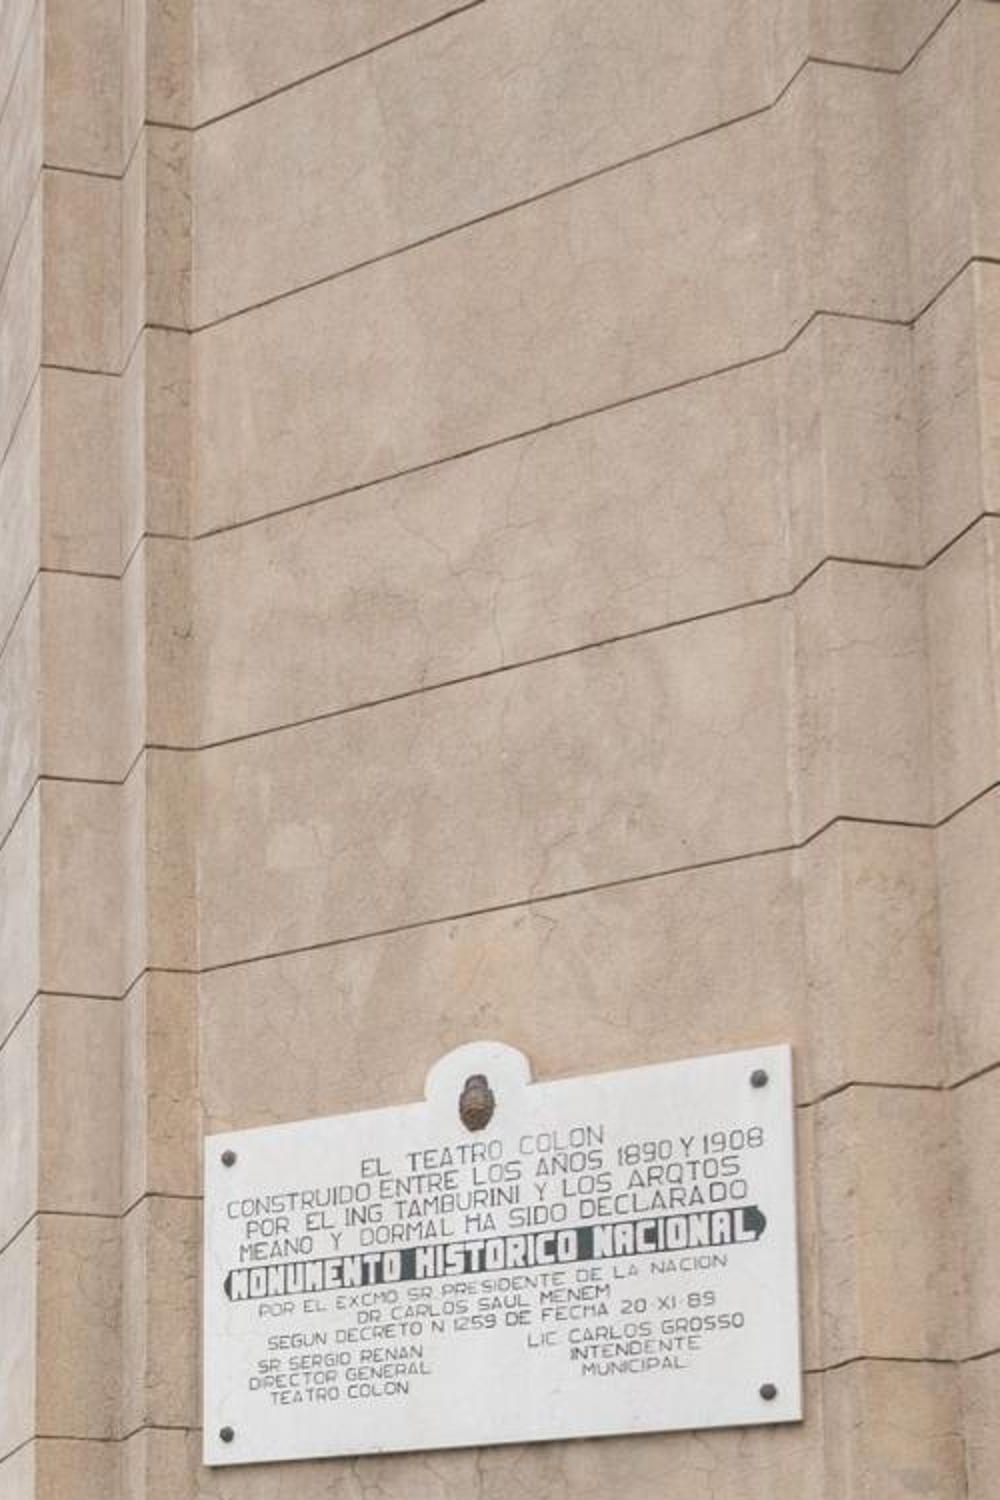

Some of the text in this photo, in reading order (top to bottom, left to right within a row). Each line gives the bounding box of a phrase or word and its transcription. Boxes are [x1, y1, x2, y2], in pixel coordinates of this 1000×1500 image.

[227, 1183, 371, 1219] CONSTRUIDO
[379, 1170, 459, 1198] ENTRE
[473, 1161, 521, 1185] LOS
[617, 1139, 673, 1167] 1890
[680, 1136, 695, 1157] Y
[703, 1127, 764, 1155] 1908
[361, 1124, 604, 1179] EL TEATRO COLON
[247, 1155, 741, 1239] POR EL ING TAMBURINI Y LOS ARQTOS
[240, 1179, 748, 1263] MEANO Y DORMAL HA SIDO DECLARADO
[230, 1208, 758, 1301] MONUMENTO HISTORICO NACIONAL
[258, 1253, 728, 1318] POR EL EXCMO SR PRESIDENTE DE LA NACION
[357, 1283, 611, 1325] DR CARLOS SAUL MENEM
[268, 1333, 327, 1351] SEGUN
[336, 1322, 423, 1344] DECRETO
[453, 1313, 497, 1332] 1259
[505, 1311, 532, 1327] DE
[542, 1303, 609, 1322] FECHA
[620, 1298, 647, 1315] 20
[528, 1312, 745, 1348] LIC CARLOS GROSSO
[570, 1334, 703, 1360] INTENDENTE
[258, 1345, 424, 1374] SR SERGIO RENAN
[346, 1362, 431, 1381] GENERAL
[582, 1356, 688, 1377] MUNICIPAL
[270, 1381, 409, 1405] TEATRO COLON
